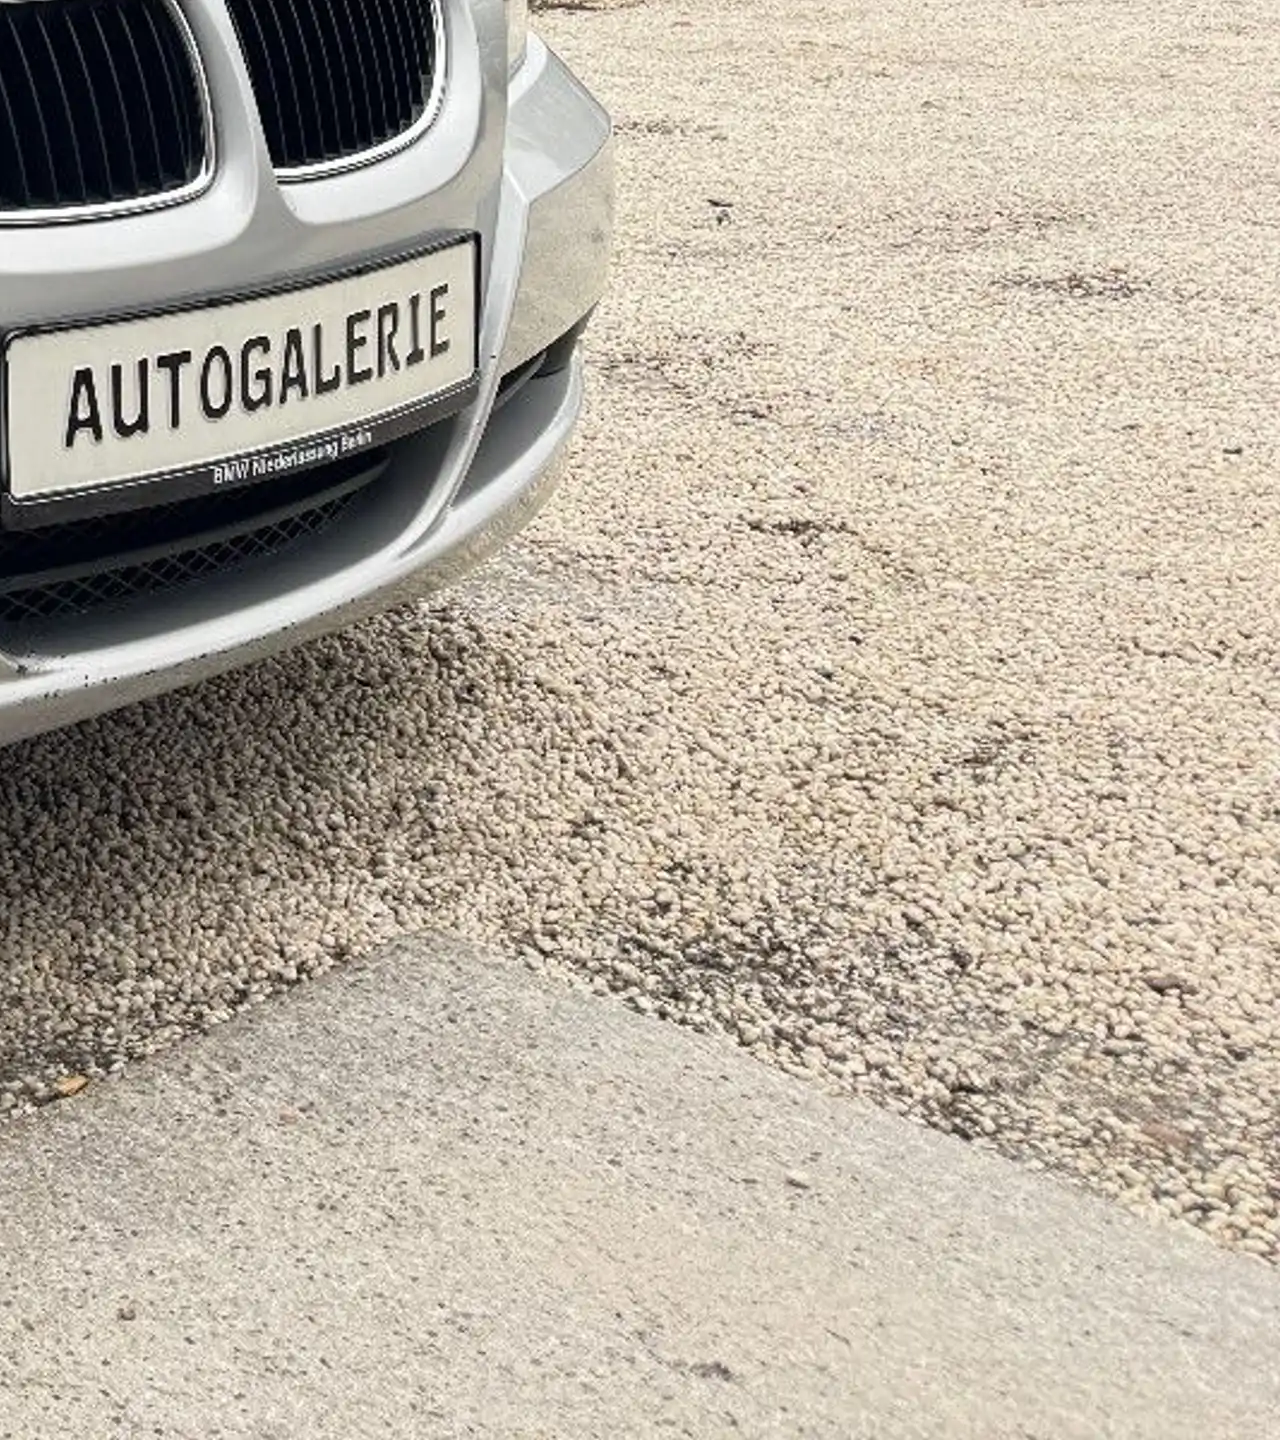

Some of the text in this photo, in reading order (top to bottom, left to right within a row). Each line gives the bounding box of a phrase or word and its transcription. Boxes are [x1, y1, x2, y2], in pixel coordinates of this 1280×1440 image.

[65, 283, 451, 449] AUTOGALERIE
[213, 431, 373, 485] BMW Niederlassung Berlin
